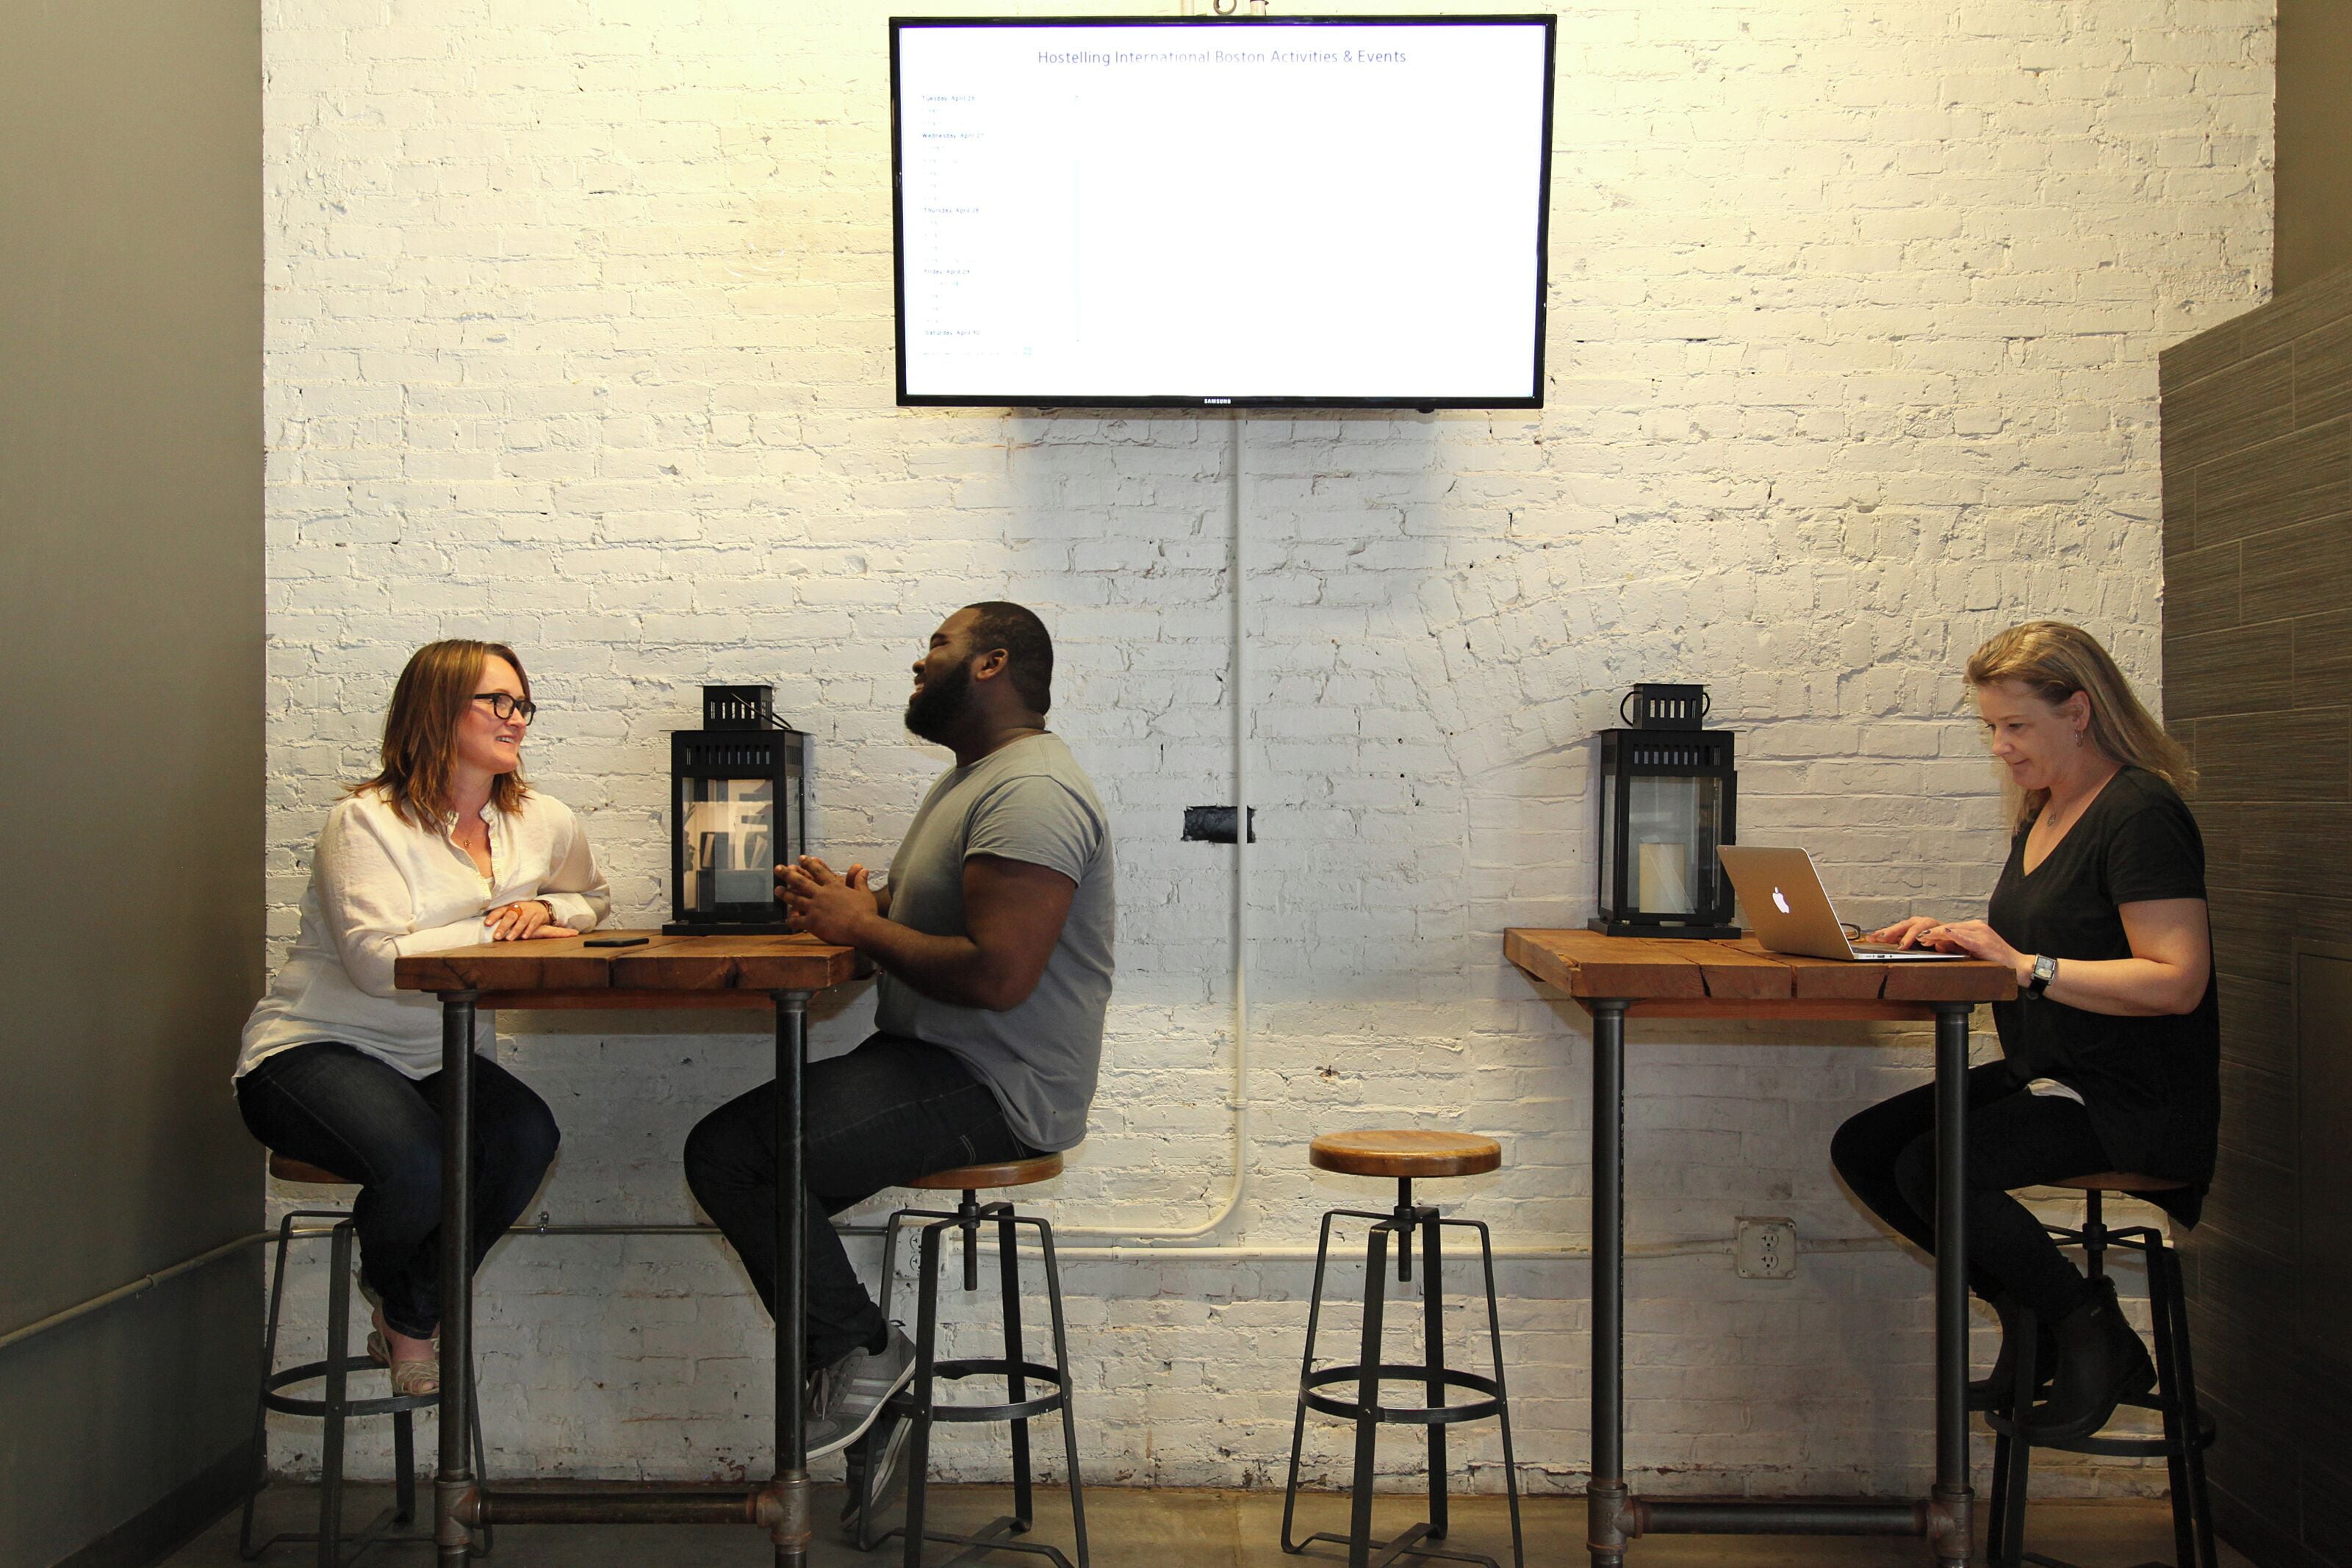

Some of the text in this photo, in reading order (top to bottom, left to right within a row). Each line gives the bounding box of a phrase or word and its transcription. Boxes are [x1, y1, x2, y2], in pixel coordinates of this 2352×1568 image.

[1039, 50, 1406, 66] Hostelling International Boston Activities & Events
